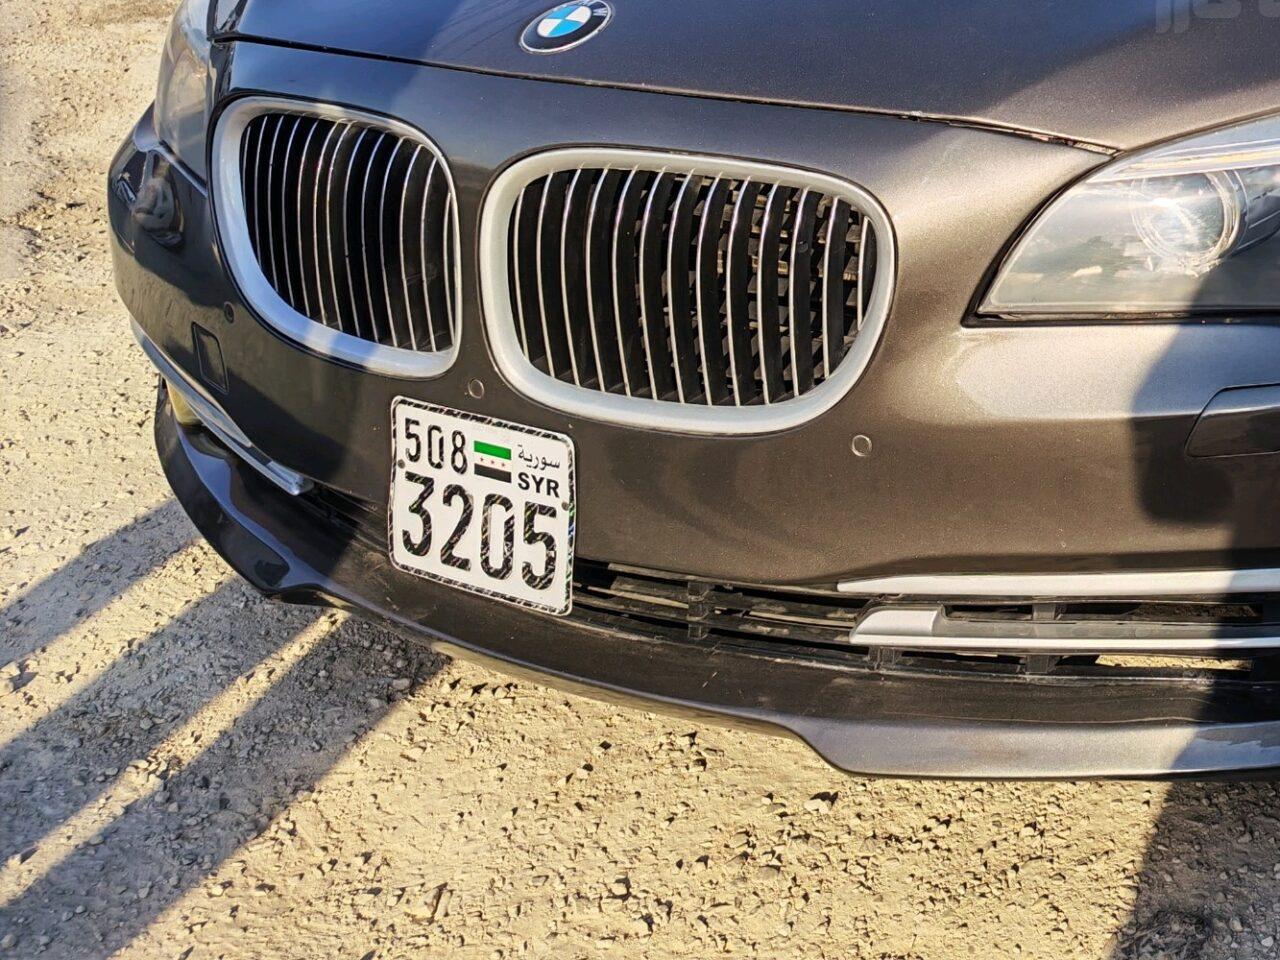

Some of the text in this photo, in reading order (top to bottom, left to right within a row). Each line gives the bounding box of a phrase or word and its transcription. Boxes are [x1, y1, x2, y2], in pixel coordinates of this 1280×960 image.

[404, 417, 468, 475] 508
[517, 443, 561, 470] سورية
[517, 471, 560, 498] SYR
[401, 471, 558, 591] 3205
